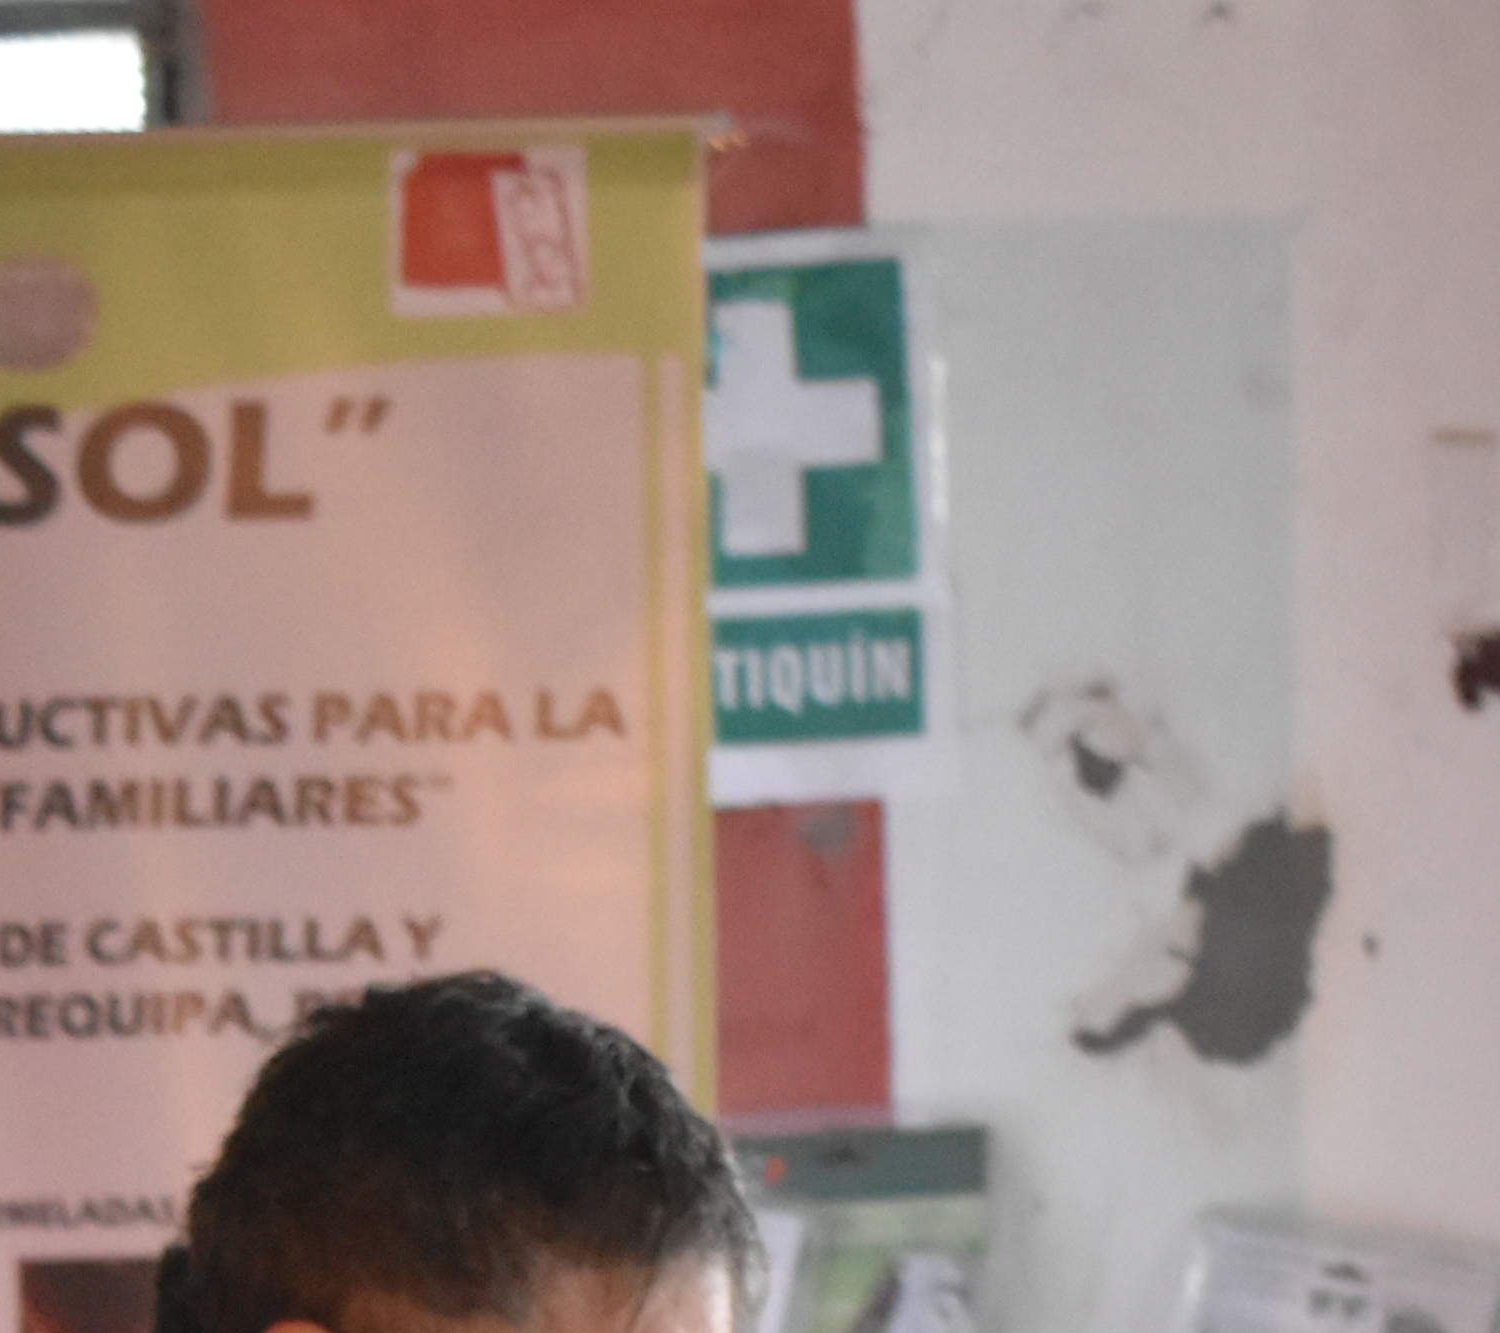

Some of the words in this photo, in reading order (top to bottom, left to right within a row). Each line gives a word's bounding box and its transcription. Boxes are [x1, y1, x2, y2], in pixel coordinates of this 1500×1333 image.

[311, 688, 512, 745] PARA
[534, 686, 629, 742] LA
[86, 916, 384, 966] CASTILLA
[404, 916, 443, 961] Y
